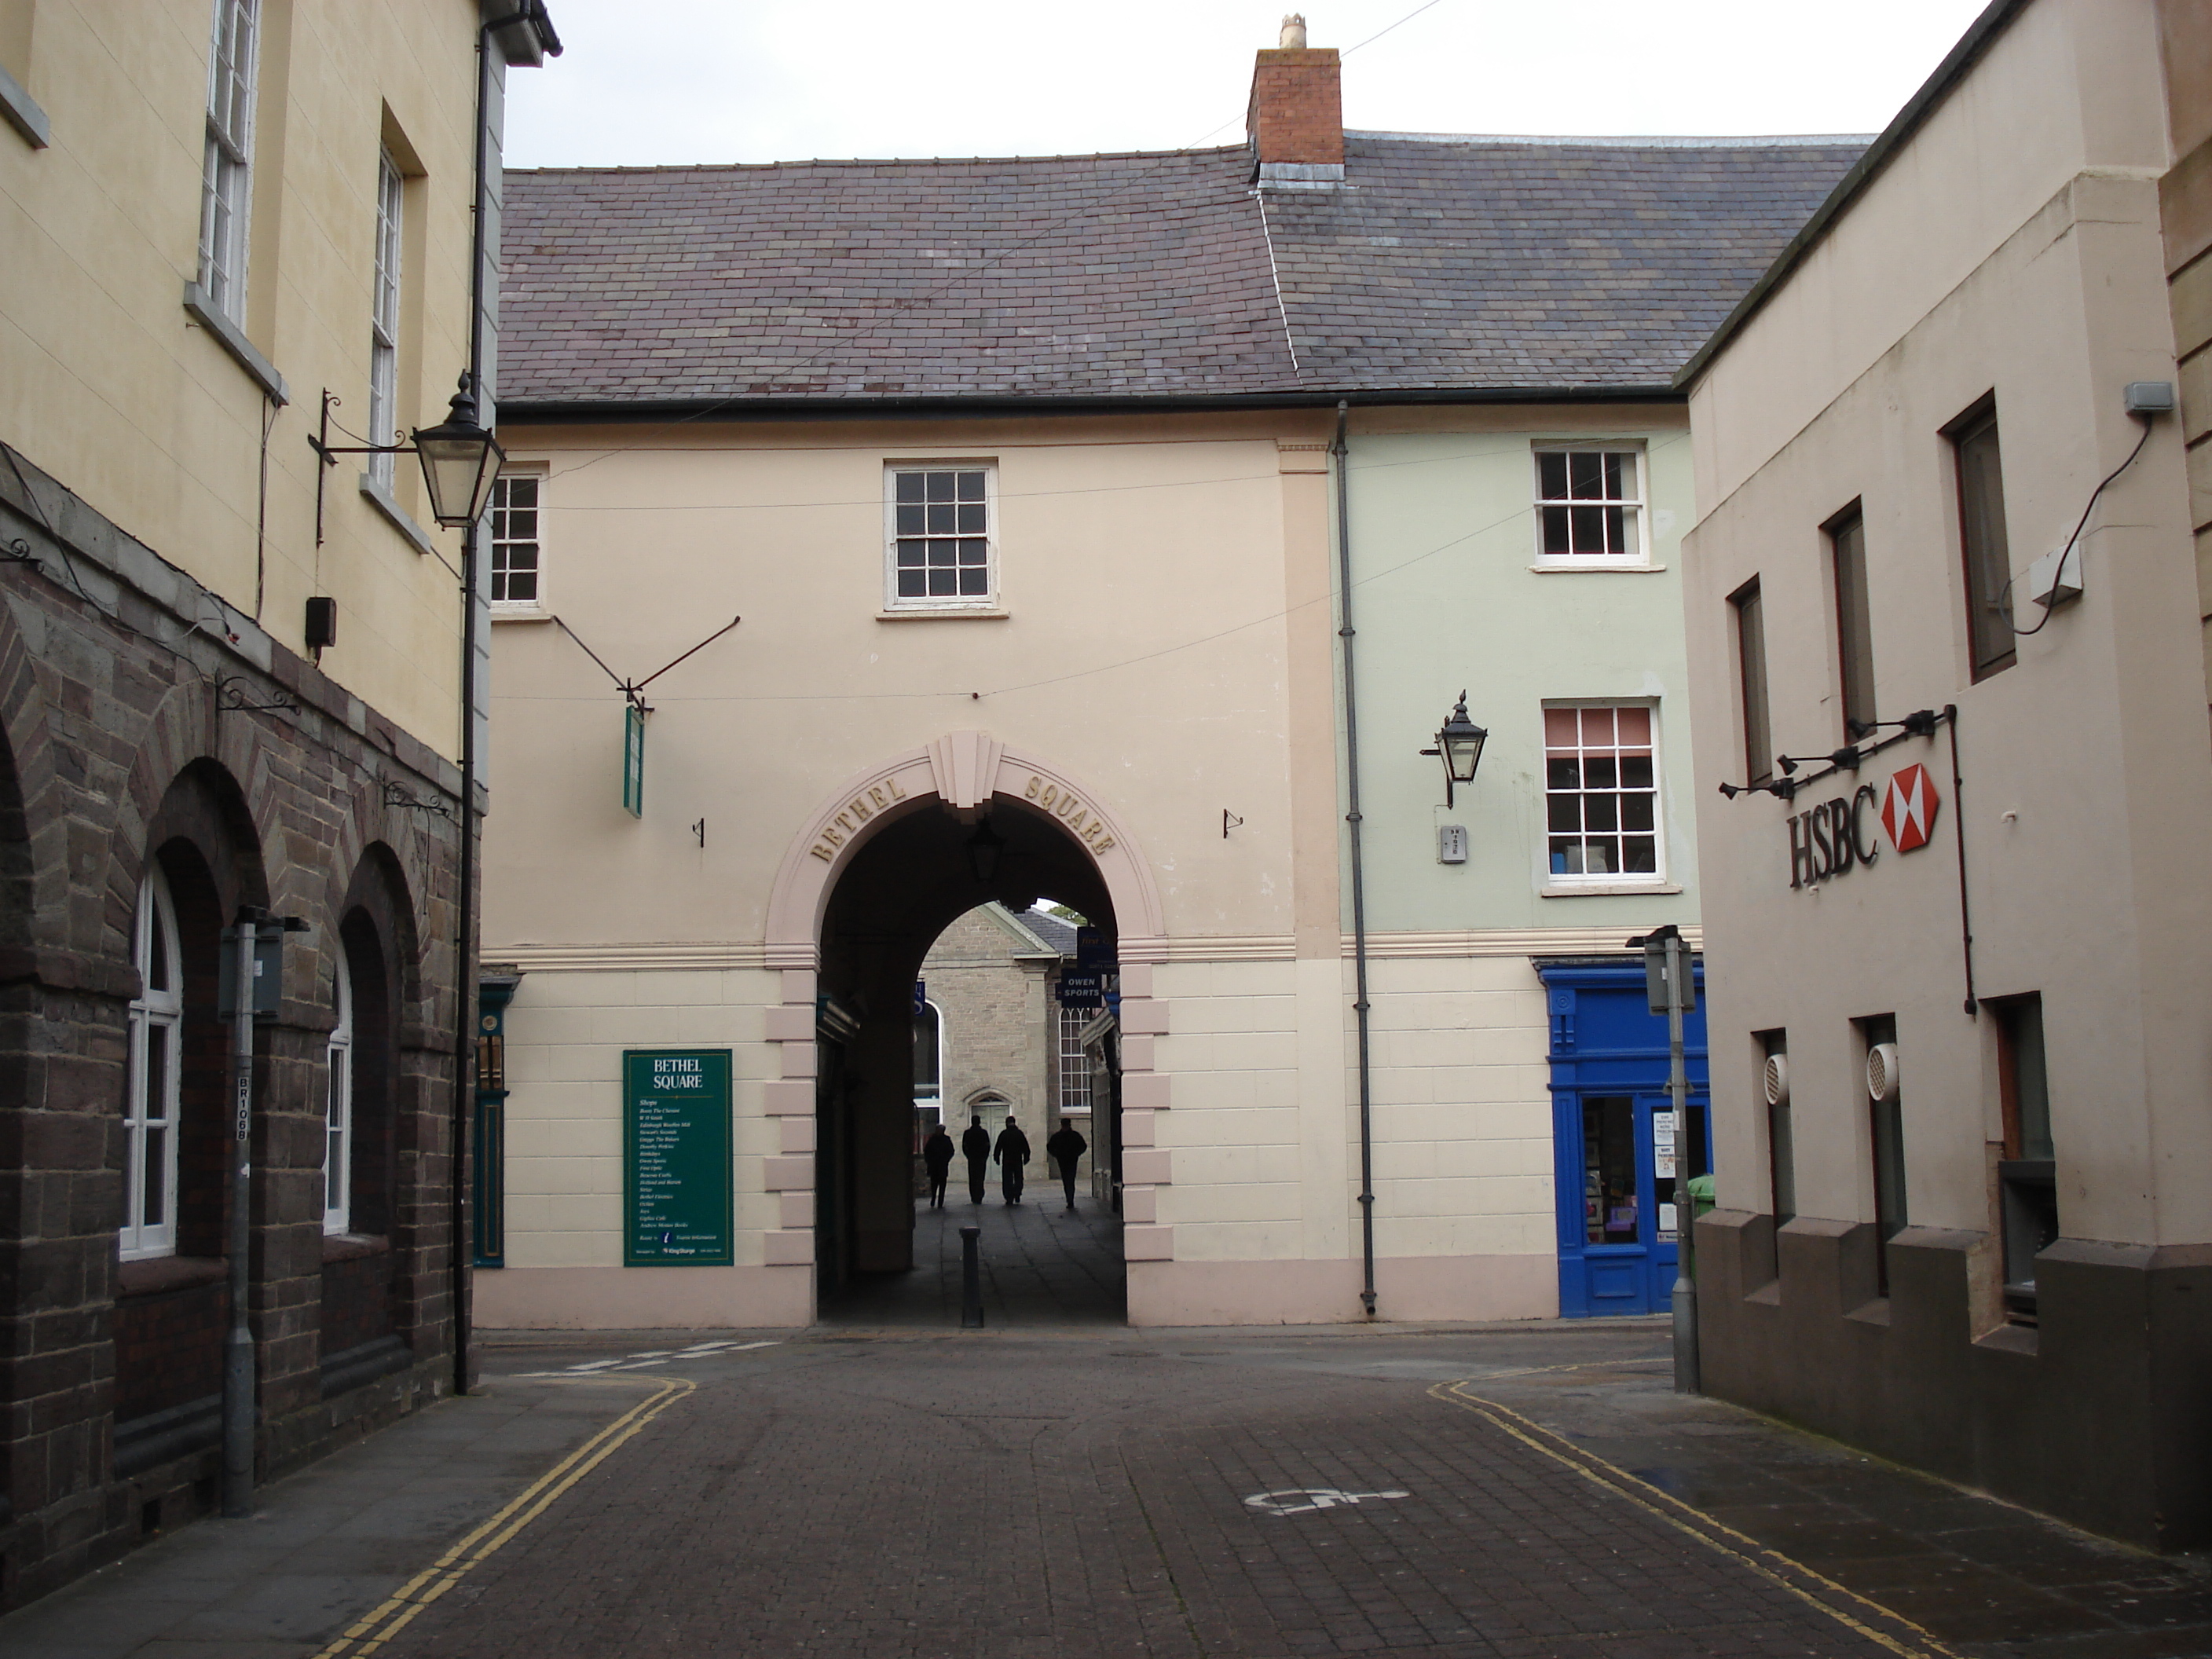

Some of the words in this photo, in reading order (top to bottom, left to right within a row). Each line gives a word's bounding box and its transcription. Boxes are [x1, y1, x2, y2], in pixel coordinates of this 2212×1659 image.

[811, 778, 906, 863] BETHEL
[1025, 775, 1115, 855] SQUARE
[1786, 782, 1878, 888] HSBC
[1064, 988, 1099, 997] SPORTS
[654, 1059, 702, 1072] BETHEL
[654, 1075, 702, 1090] SQUARE
[238, 1078, 247, 1139] BR1068
